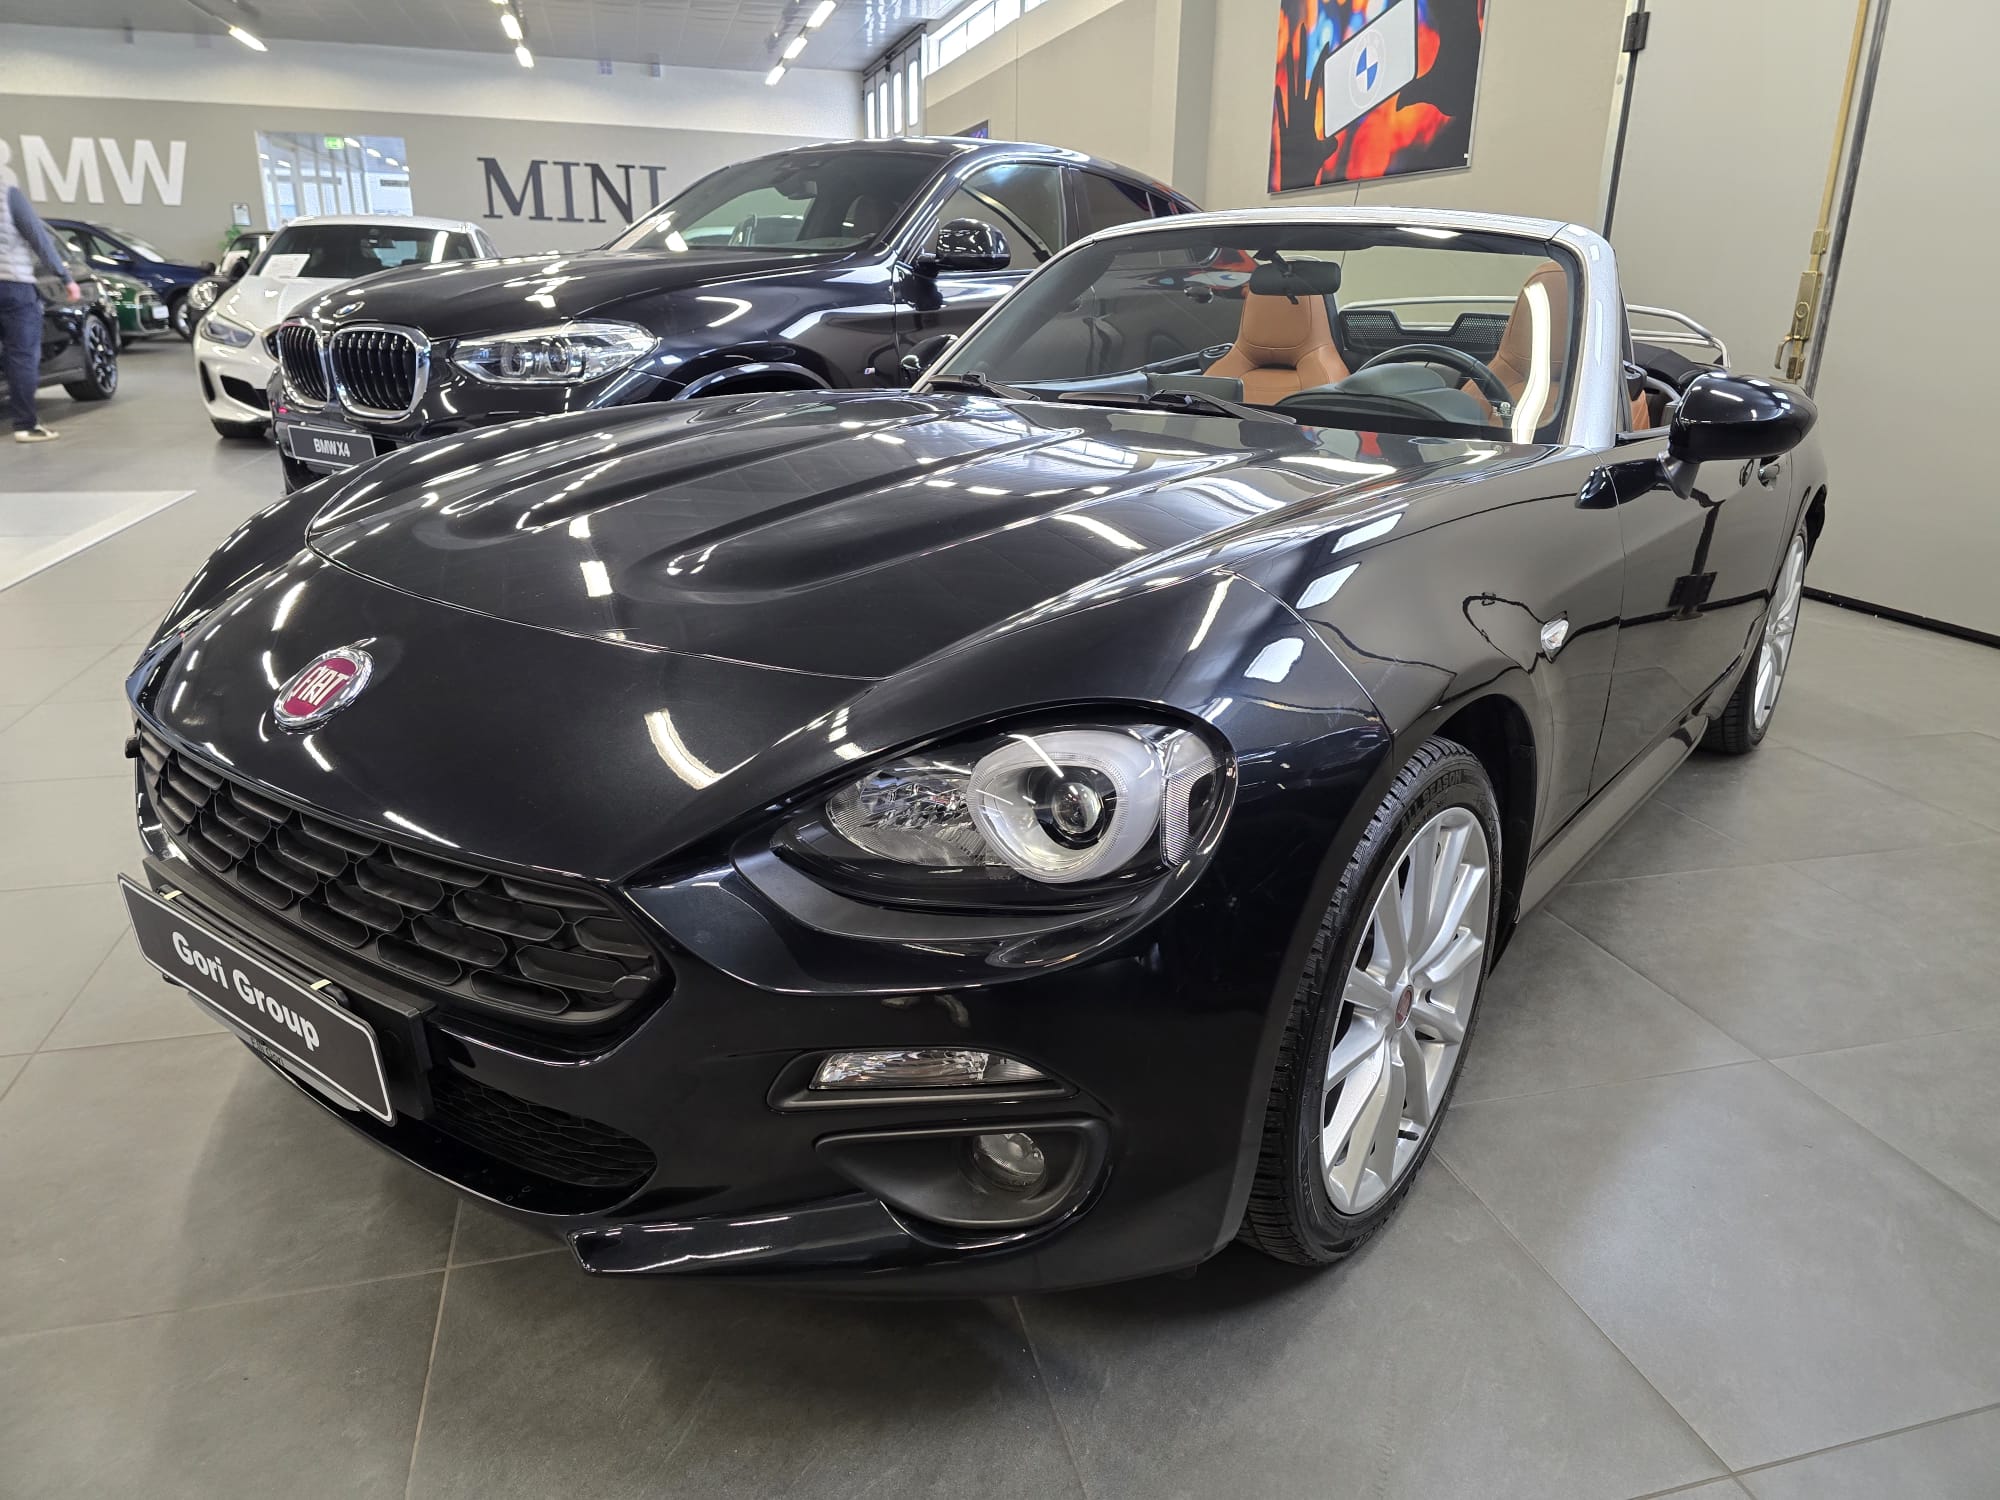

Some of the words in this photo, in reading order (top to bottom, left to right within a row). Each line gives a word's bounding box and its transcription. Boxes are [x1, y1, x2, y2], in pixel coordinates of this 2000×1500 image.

[477, 157, 666, 223] MINI
[313, 438, 337, 455] BMW
[337, 441, 351, 457] X4
[289, 665, 350, 706] FIAT
[1423, 769, 1463, 802] SEASON
[171, 931, 229, 989] Gori
[232, 968, 320, 1052] Group
